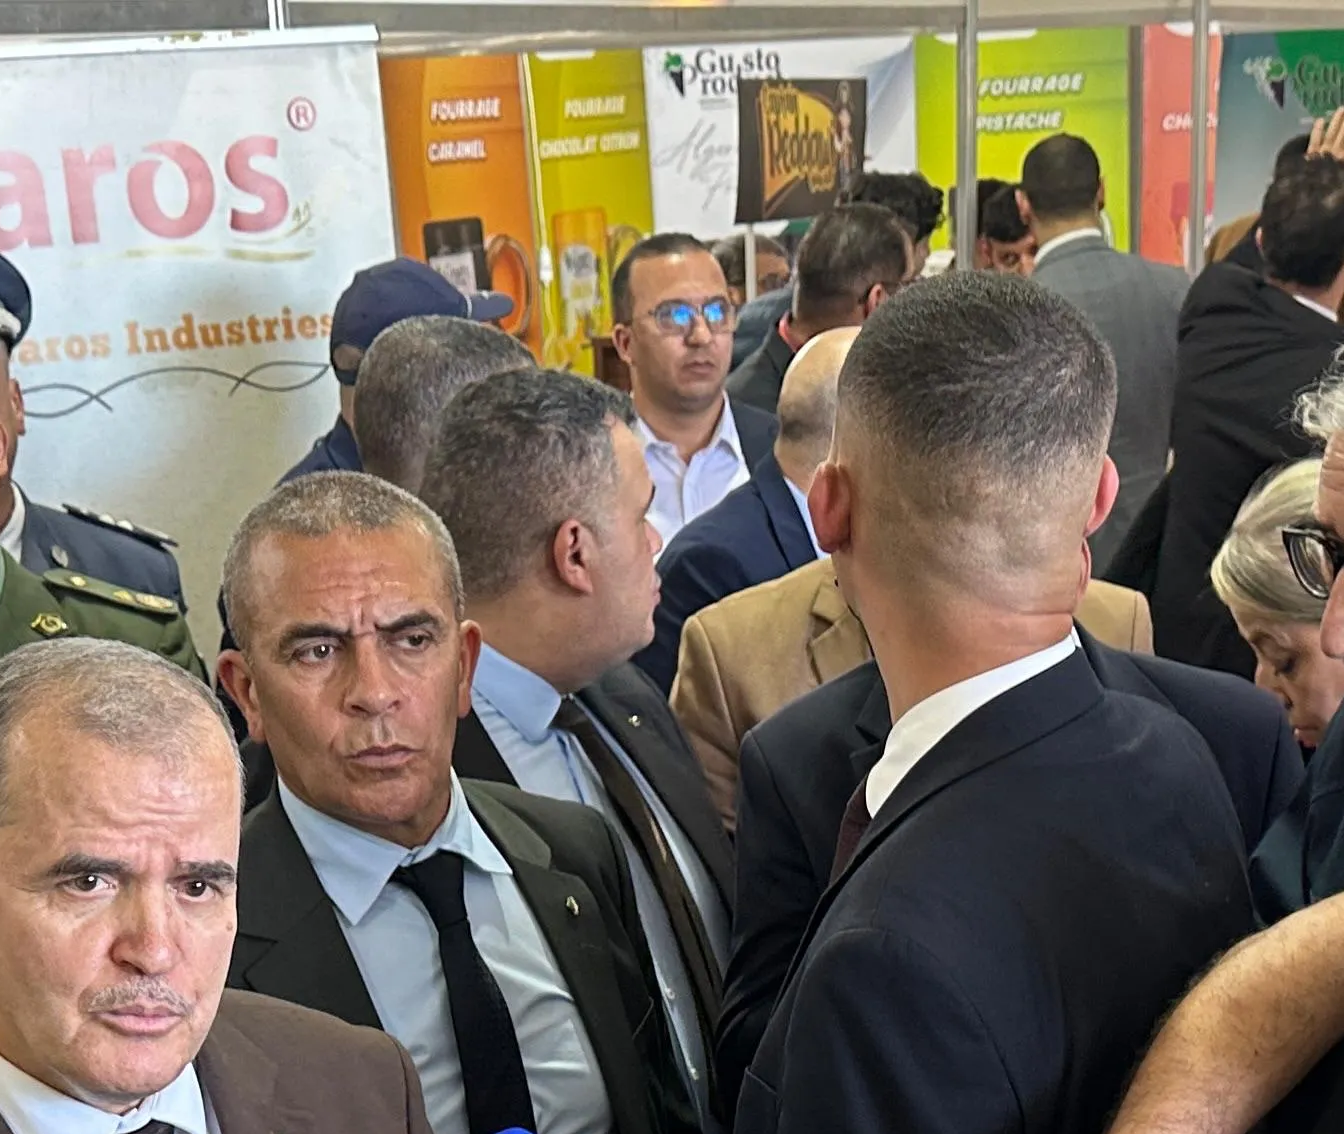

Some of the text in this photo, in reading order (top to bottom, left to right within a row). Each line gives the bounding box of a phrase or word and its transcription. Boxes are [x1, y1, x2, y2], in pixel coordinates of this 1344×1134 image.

[978, 73, 1085, 97] FOURRAGE
[17, 307, 333, 367] aros Industries
